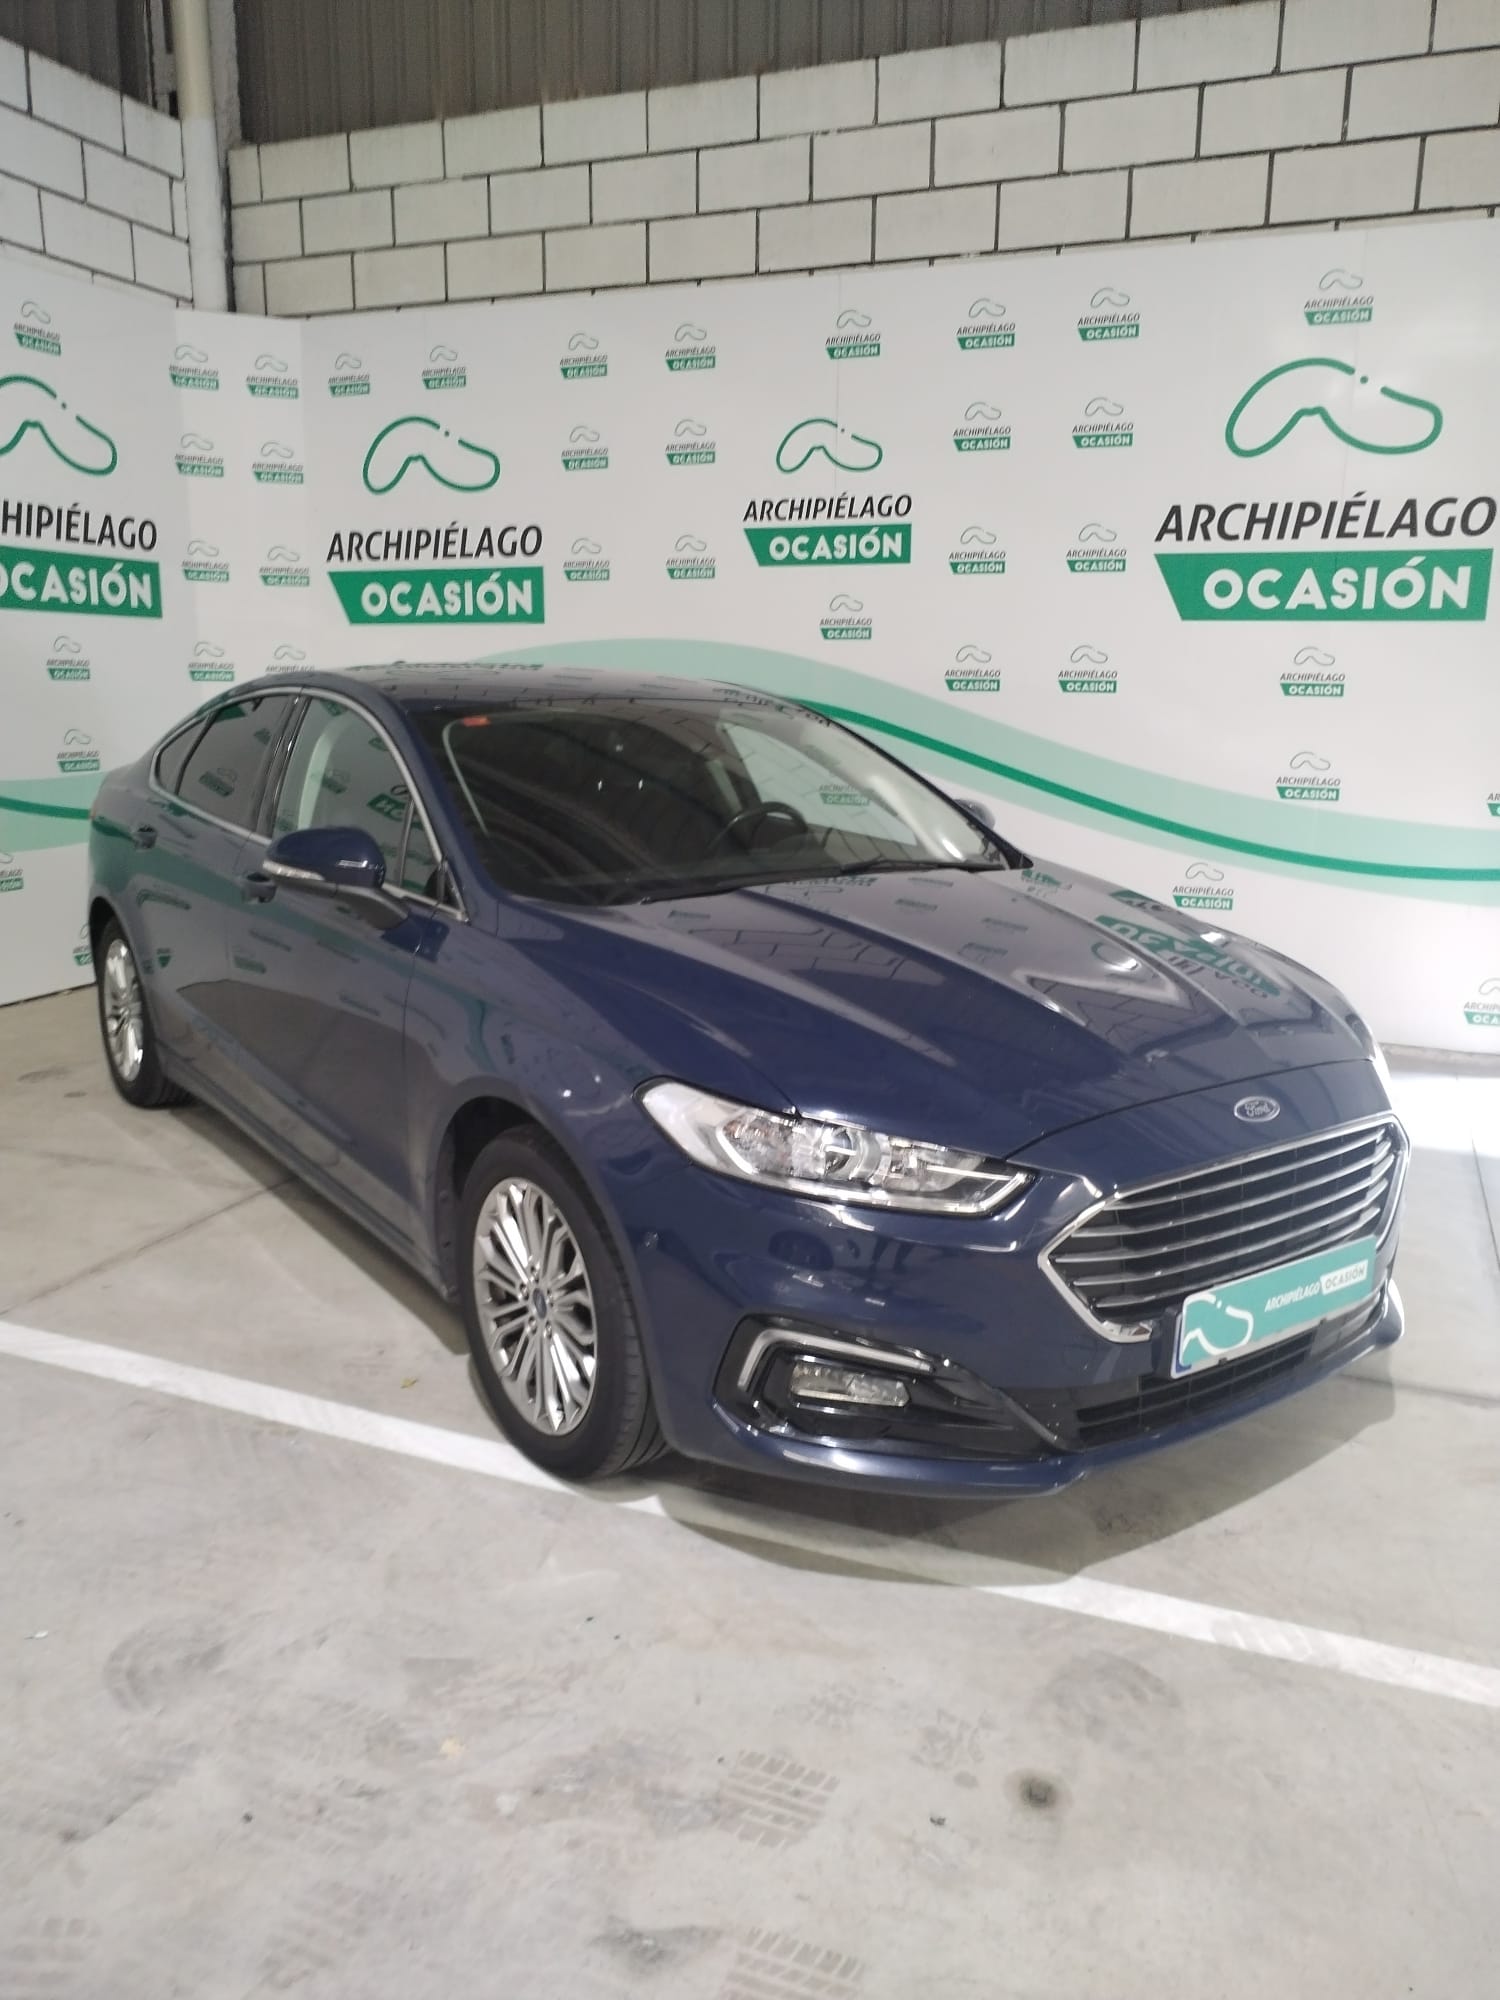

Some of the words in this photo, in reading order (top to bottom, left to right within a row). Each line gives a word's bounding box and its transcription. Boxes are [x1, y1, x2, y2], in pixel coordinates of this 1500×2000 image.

[1304, 296, 1374, 310] ARCHIPIÉLAGO
[1078, 312, 1140, 326] ARCHIPIÉLAGO
[1313, 308, 1370, 323] OCASIÓN
[956, 322, 1015, 336] ARCHIPIÉLAGO
[1086, 325, 1137, 339] OCASIÓN
[826, 332, 880, 345] ARCHIPIÉLAGO
[964, 334, 1013, 348] OCASIÓN
[833, 345, 879, 358] OCASIÓN
[953, 426, 1011, 437] ARCHIPIÉLAGO
[1072, 422, 1134, 434] ARCHIPIÉLAGO
[666, 441, 716, 452] ARCHIPIÉLAGO
[961, 438, 1009, 450] OCASIÓN
[1080, 434, 1131, 447] OCASIÓN
[672, 453, 714, 464] OCASIÓN
[743, 491, 912, 522] ARCHIPIÉLAGO
[1154, 490, 1498, 542] ARCHIPIÉLAGO
[326, 521, 543, 562] ARCHIPIÉLAGO
[769, 527, 902, 561] OCASIÓN
[949, 550, 1006, 560] ARCHIPIÉLAGO
[1066, 548, 1127, 559] ARCHIPIÉLAGO
[957, 561, 1003, 572] OCASIÓN
[1074, 559, 1125, 571] OCASIÓN
[1203, 556, 1472, 610] OCASIÓN
[360, 571, 533, 617] OCASIÓN
[820, 617, 872, 626] ARCHIPIÉLAGO
[827, 628, 869, 639] OCASIÓN
[945, 668, 1000, 678] ARCHIPIÉLAGO
[1058, 670, 1118, 680] ARCHIPIÉLAGO
[1280, 672, 1345, 682] ARCHIPIÉLAGO
[952, 680, 998, 690] OCASIÓN
[1066, 680, 1115, 692] OCASIÓN
[1289, 683, 1341, 696] OCASIÓN
[1276, 776, 1341, 787] ARCHIPIÉLAGO
[1285, 788, 1337, 801] OCASIÓN
[1173, 886, 1234, 897] ARCHIPIÉLAGO
[1181, 897, 1230, 909] OCASIÓN
[1245, 1101, 1271, 1117] Ford
[1264, 1280, 1321, 1312] ARCHIPIÉLAGO
[1325, 1263, 1366, 1290] OCASIÓN
